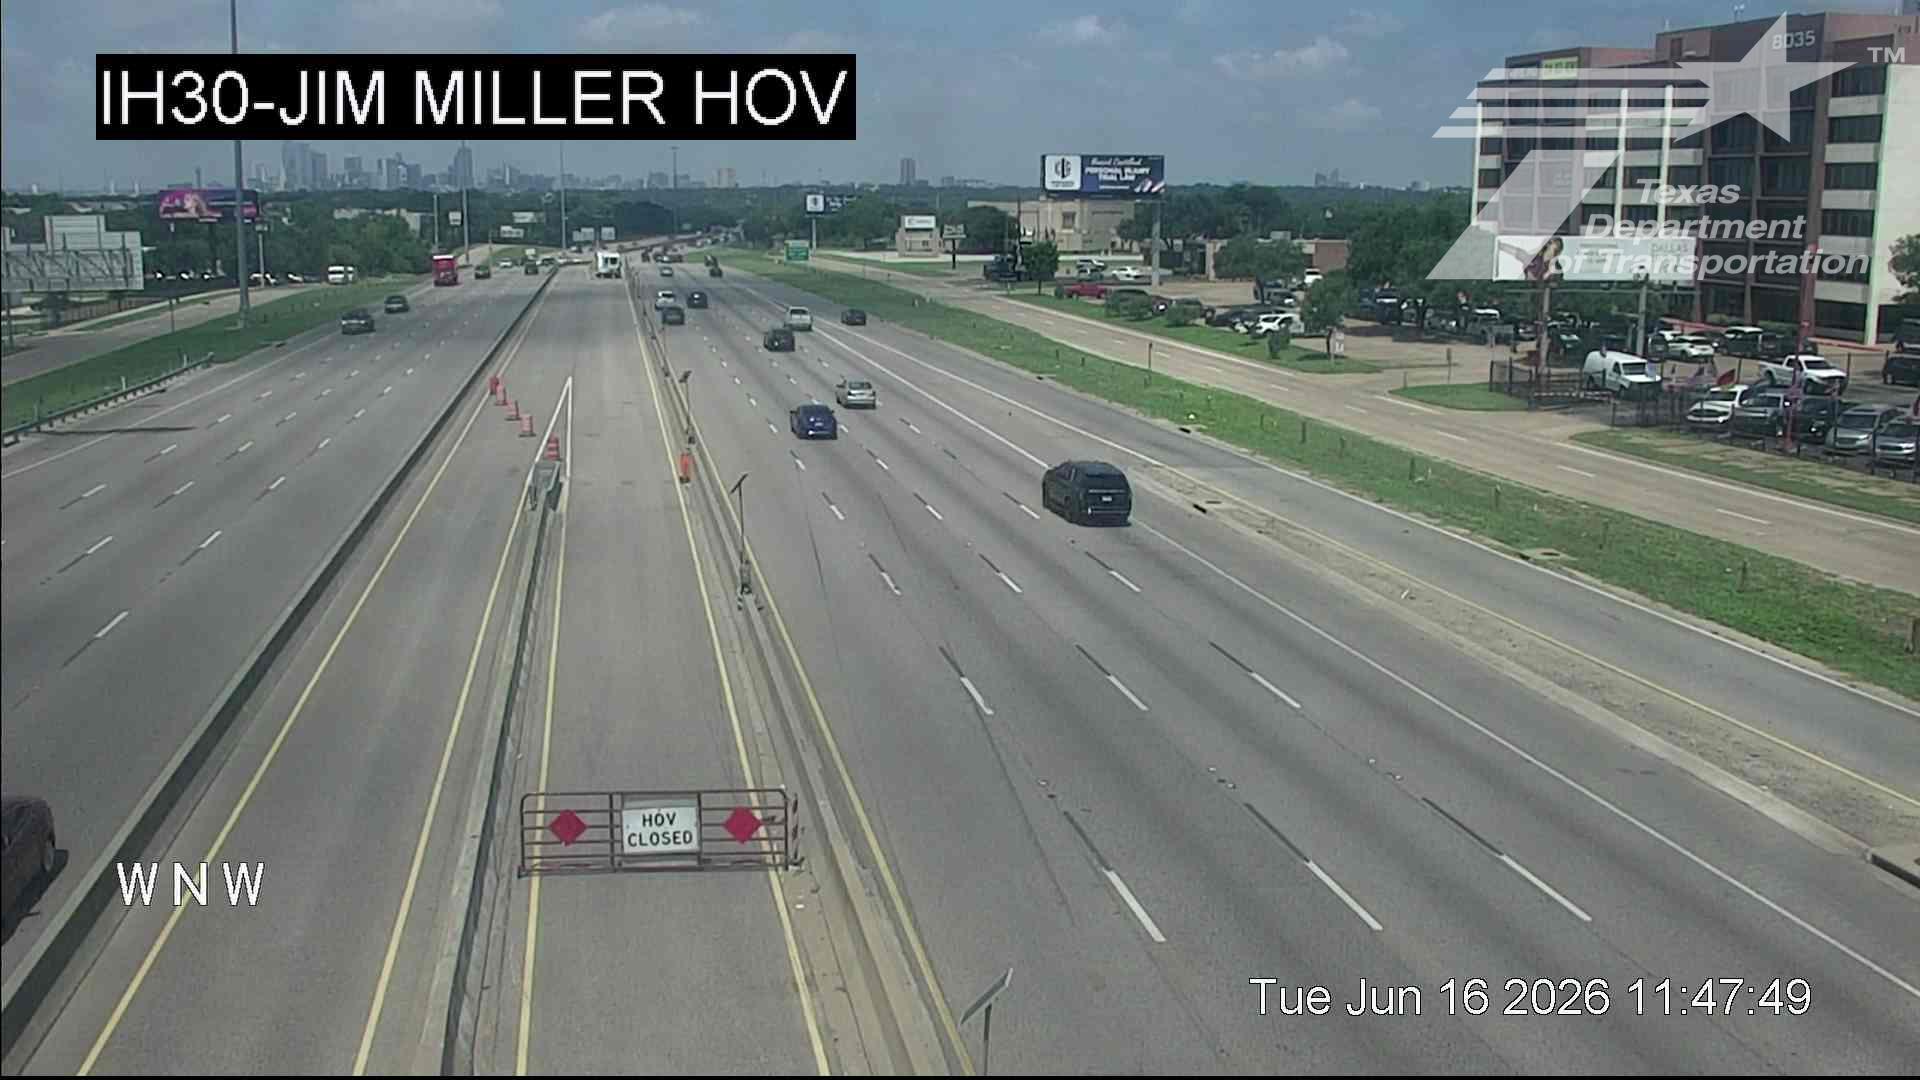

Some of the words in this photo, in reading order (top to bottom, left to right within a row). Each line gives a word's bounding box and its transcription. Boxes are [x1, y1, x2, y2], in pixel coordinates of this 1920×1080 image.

[1772, 30, 1816, 50] 8035
[642, 812, 676, 828] HOV
[627, 830, 693, 848] CLOSED
